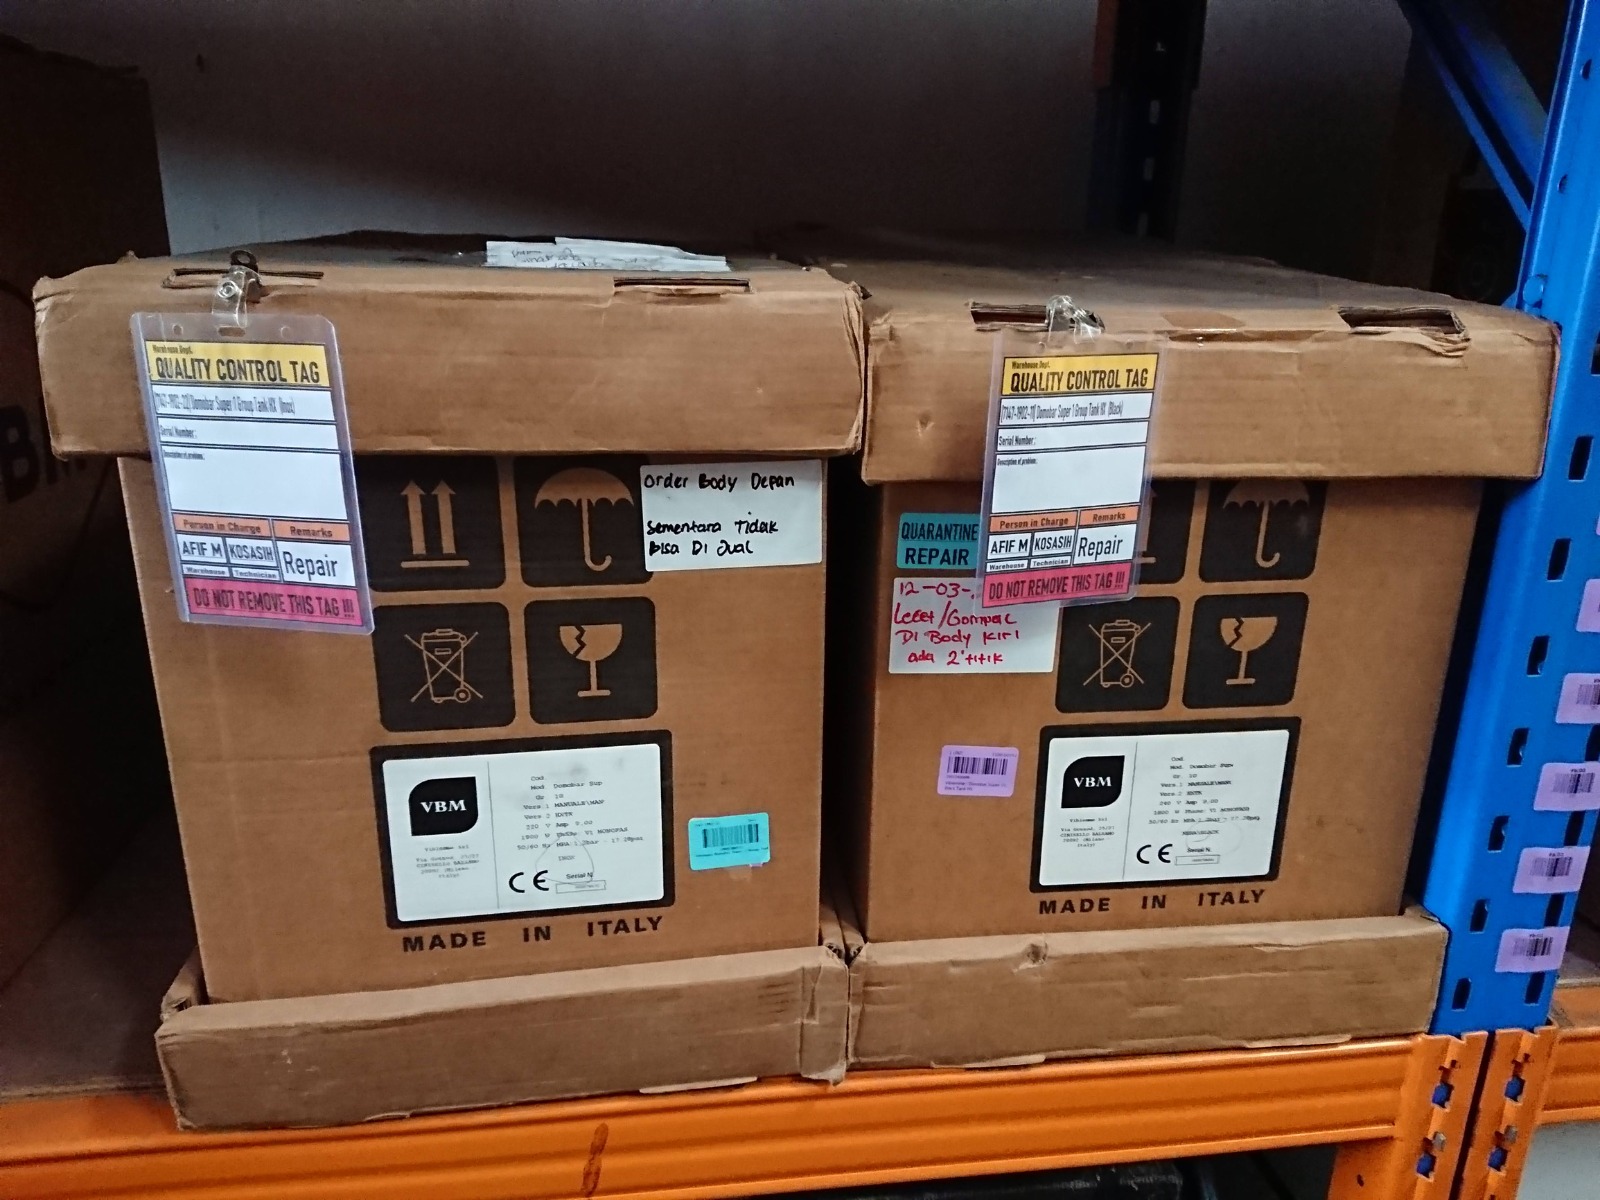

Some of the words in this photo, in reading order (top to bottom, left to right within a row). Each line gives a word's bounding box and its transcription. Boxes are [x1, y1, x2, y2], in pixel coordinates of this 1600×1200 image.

[155, 357, 211, 380] QUALITY
[216, 359, 287, 383] CONTROL
[289, 361, 320, 383] TAG
[1012, 361, 1038, 370] Warehouse
[1011, 371, 1064, 393] QUALITY
[1066, 369, 1121, 390] CONTROL
[1125, 368, 1149, 388] TAG
[998, 434, 1014, 446] Serial
[644, 472, 689, 489] Order
[698, 473, 738, 493] Body
[1000, 519, 1029, 529] Person
[1031, 518, 1038, 527] in
[1041, 516, 1069, 527] Charge
[1093, 512, 1126, 522] Remarks
[183, 519, 214, 530] Person
[216, 521, 226, 530] in
[228, 522, 262, 534] Charge
[290, 526, 333, 537] Remarks
[646, 520, 722, 535] Sementara
[901, 521, 979, 542] QUARANTINE
[182, 541, 208, 556] AFIF
[211, 543, 223, 557] M
[990, 540, 1016, 554] AFIF
[1018, 538, 1029, 552] M
[1034, 535, 1073, 551] KOSASIH
[1078, 534, 1124, 561] Repair
[228, 544, 274, 561] KOSASIH
[904, 547, 970, 566] REPAIR
[283, 551, 338, 581] Repair
[989, 562, 1025, 571] Warehouse
[1033, 558, 1069, 567] Technician
[186, 566, 226, 576] Warehouse
[234, 569, 277, 579] Technician
[989, 583, 1003, 600] DO
[1005, 580, 1026, 599] NOT
[1028, 576, 1069, 597] REMOVE
[1070, 573, 1093, 592] THIS
[1094, 571, 1112, 590] TAG
[193, 588, 210, 606] DO
[212, 588, 235, 609] NOT
[239, 591, 287, 613] REMOVE
[287, 593, 315, 615] THIS
[315, 597, 340, 617] TAG
[926, 628, 972, 649] Body
[1074, 776, 1113, 788] VBM
[420, 799, 467, 814] VBM
[1038, 896, 1112, 915] MADE
[1141, 893, 1168, 910] IN
[1197, 888, 1267, 908] ITALY
[402, 930, 487, 953] MADE
[523, 925, 551, 943] IN
[587, 915, 664, 938] ITALY
